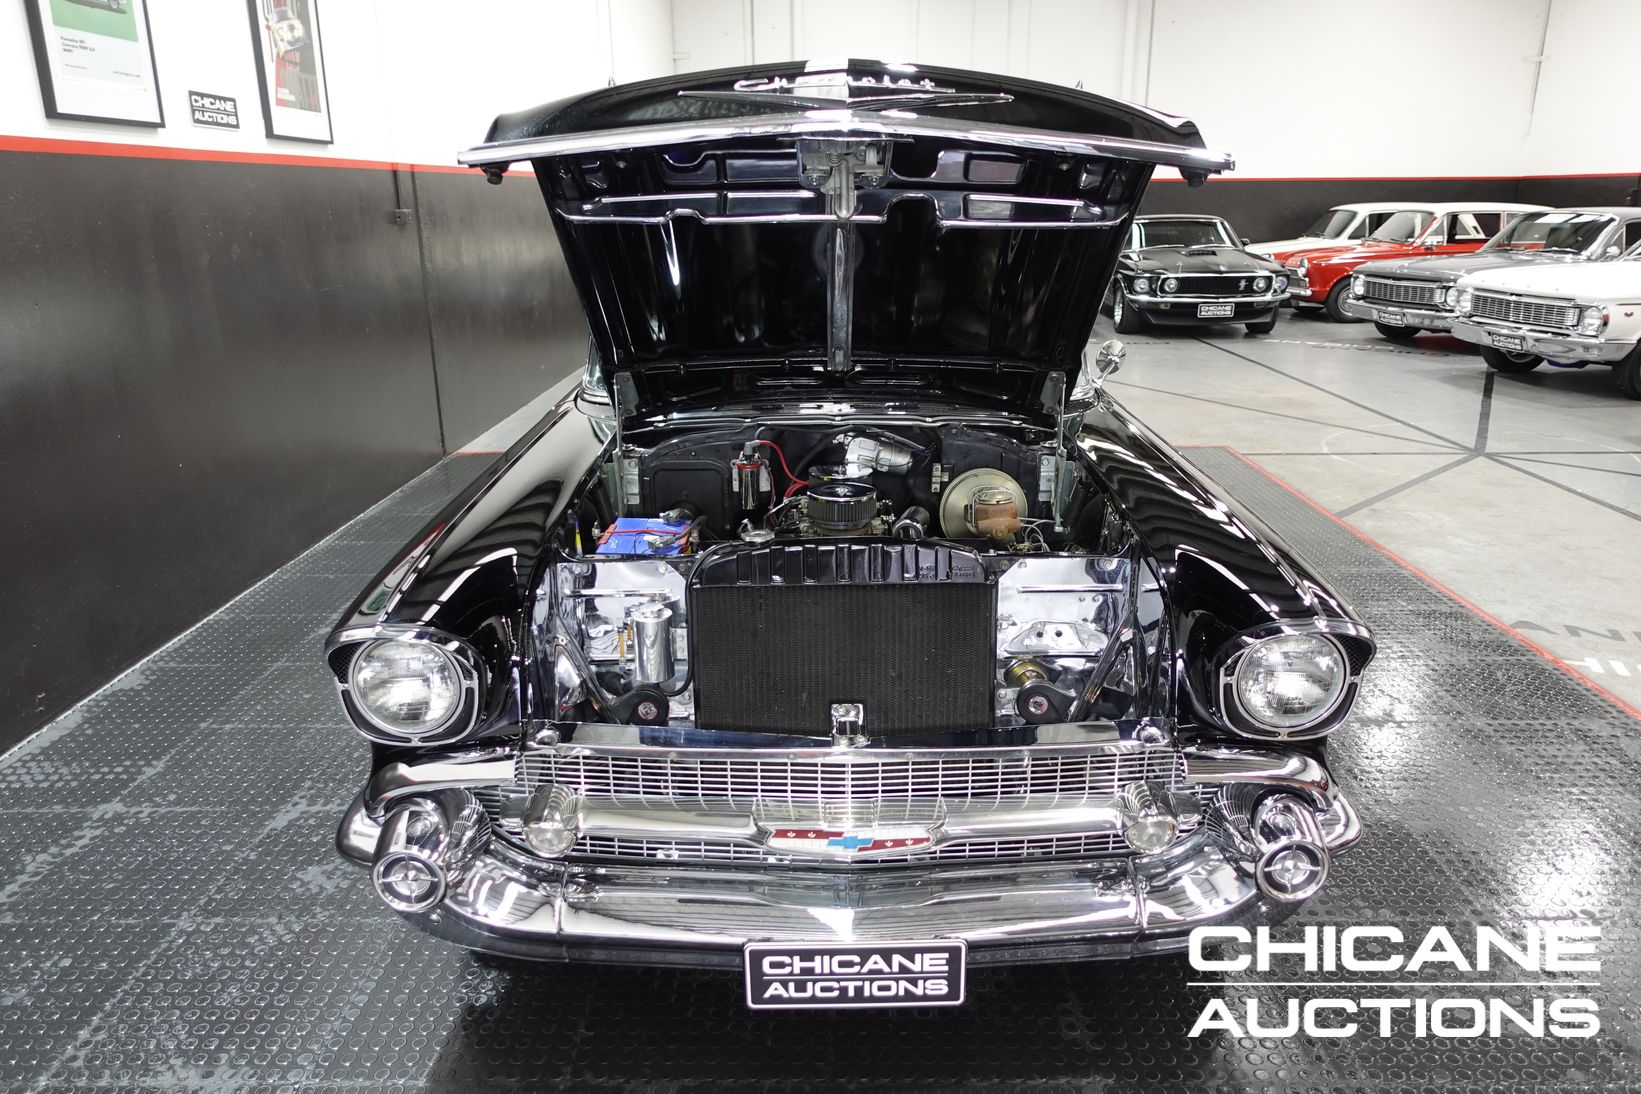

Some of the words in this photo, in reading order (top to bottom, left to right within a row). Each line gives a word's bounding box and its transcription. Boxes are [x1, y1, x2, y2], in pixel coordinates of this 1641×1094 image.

[191, 95, 236, 112] CHICANE
[194, 110, 237, 125] AUCTIONS
[762, 953, 949, 974] CHICANE
[762, 979, 949, 998] AUCTIONS
